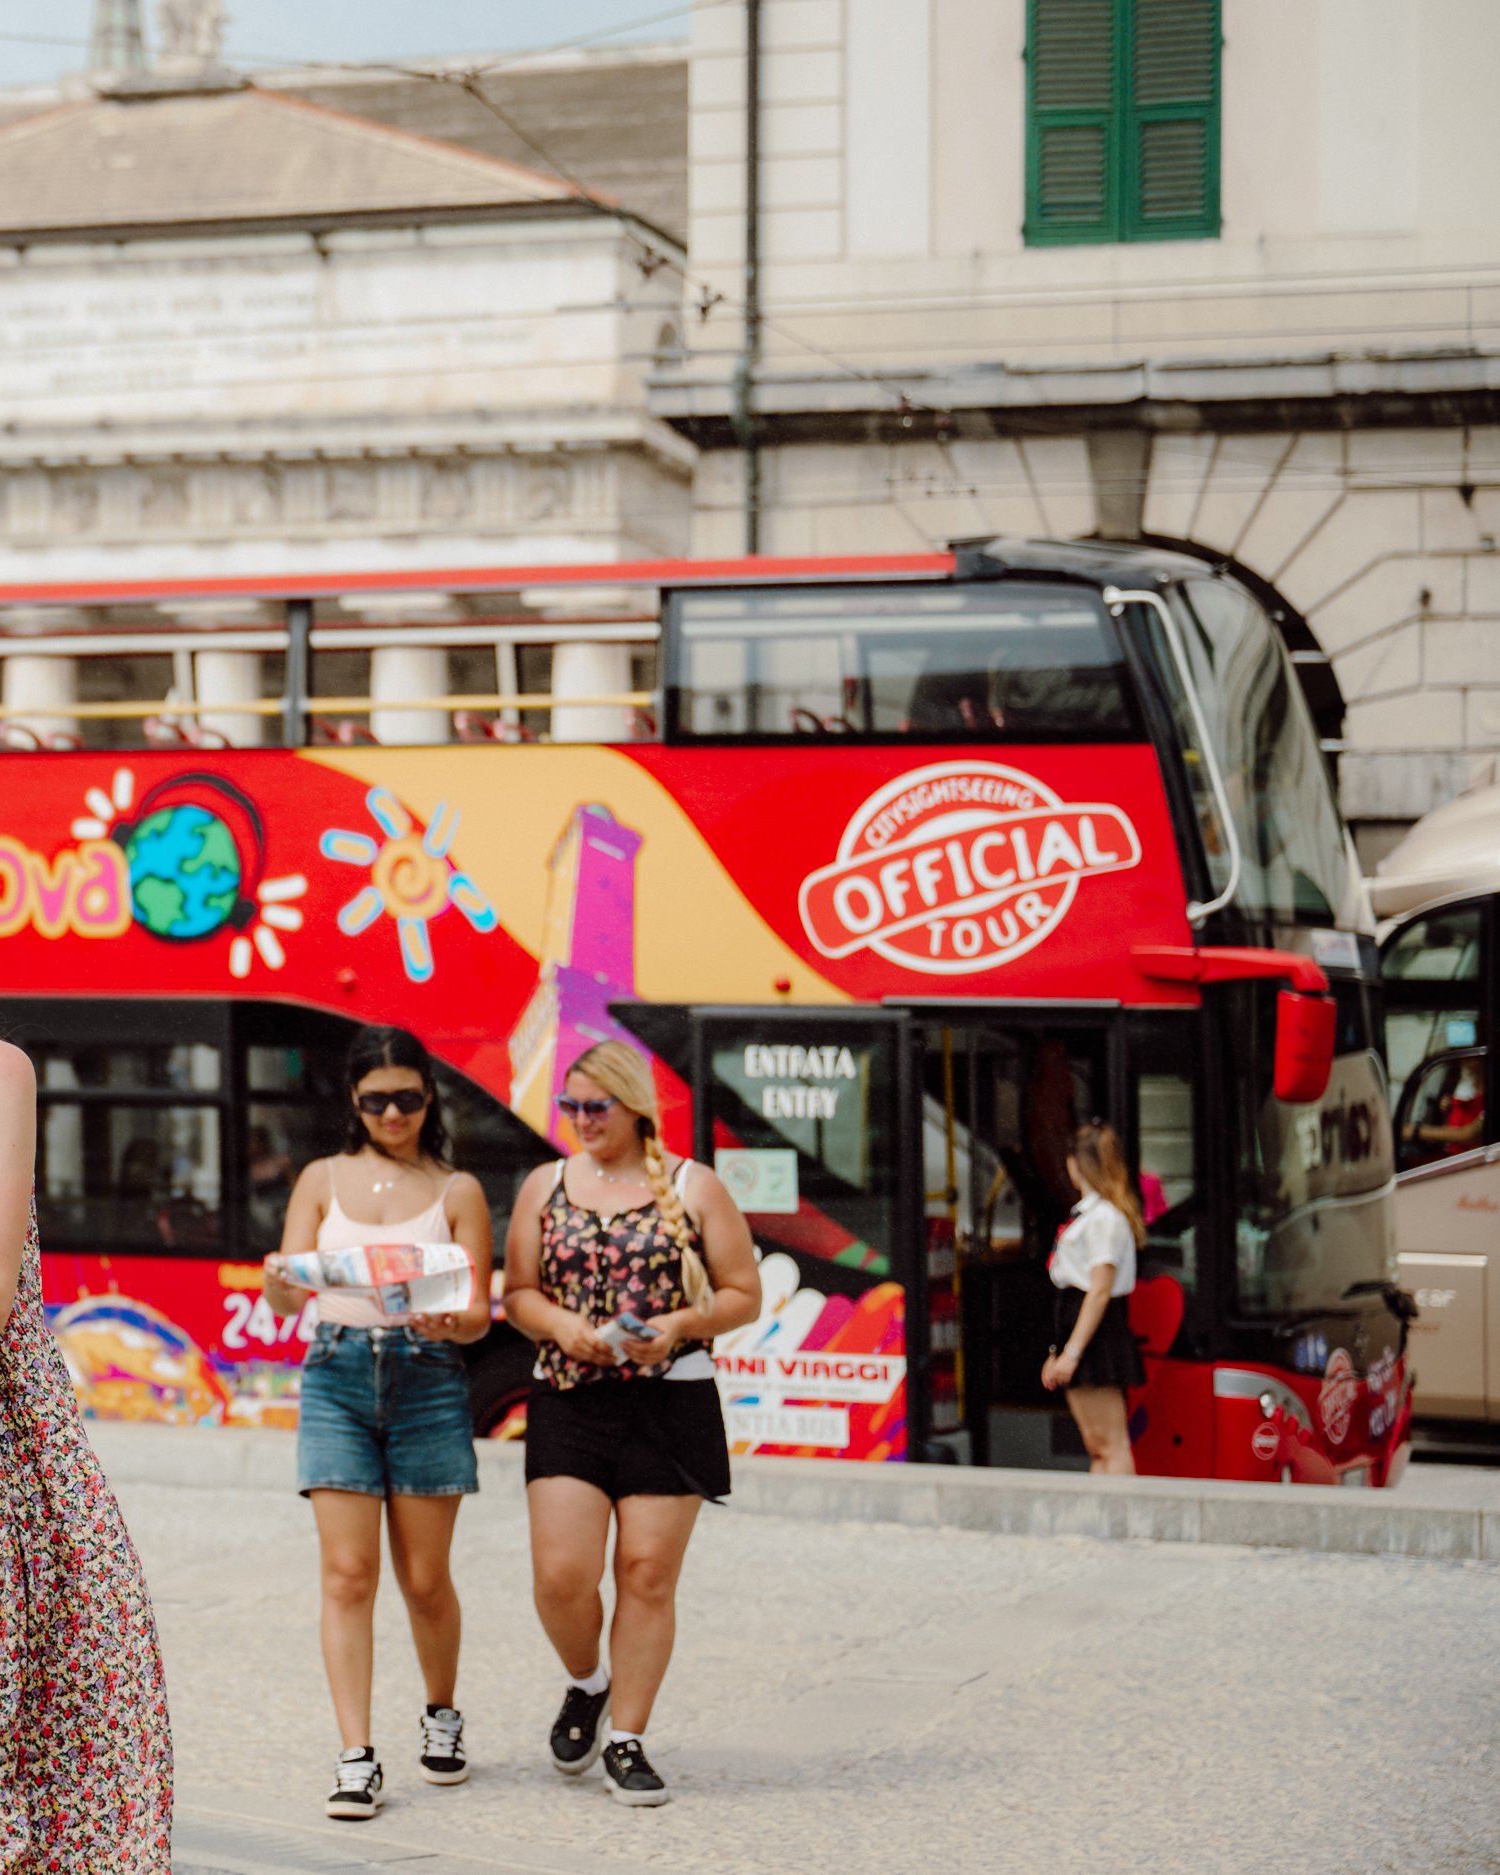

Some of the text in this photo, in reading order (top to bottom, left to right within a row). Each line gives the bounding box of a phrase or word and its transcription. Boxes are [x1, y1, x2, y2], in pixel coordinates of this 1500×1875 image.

[864, 776, 1036, 850] CITYSIGHTSEEING
[833, 815, 1118, 934] OFFICIAL
[926, 891, 1053, 956] TOUR
[744, 1043, 857, 1079] ENTRATA
[762, 1084, 840, 1119] ENTRY
[777, 1359, 890, 1382] VIAGGI
